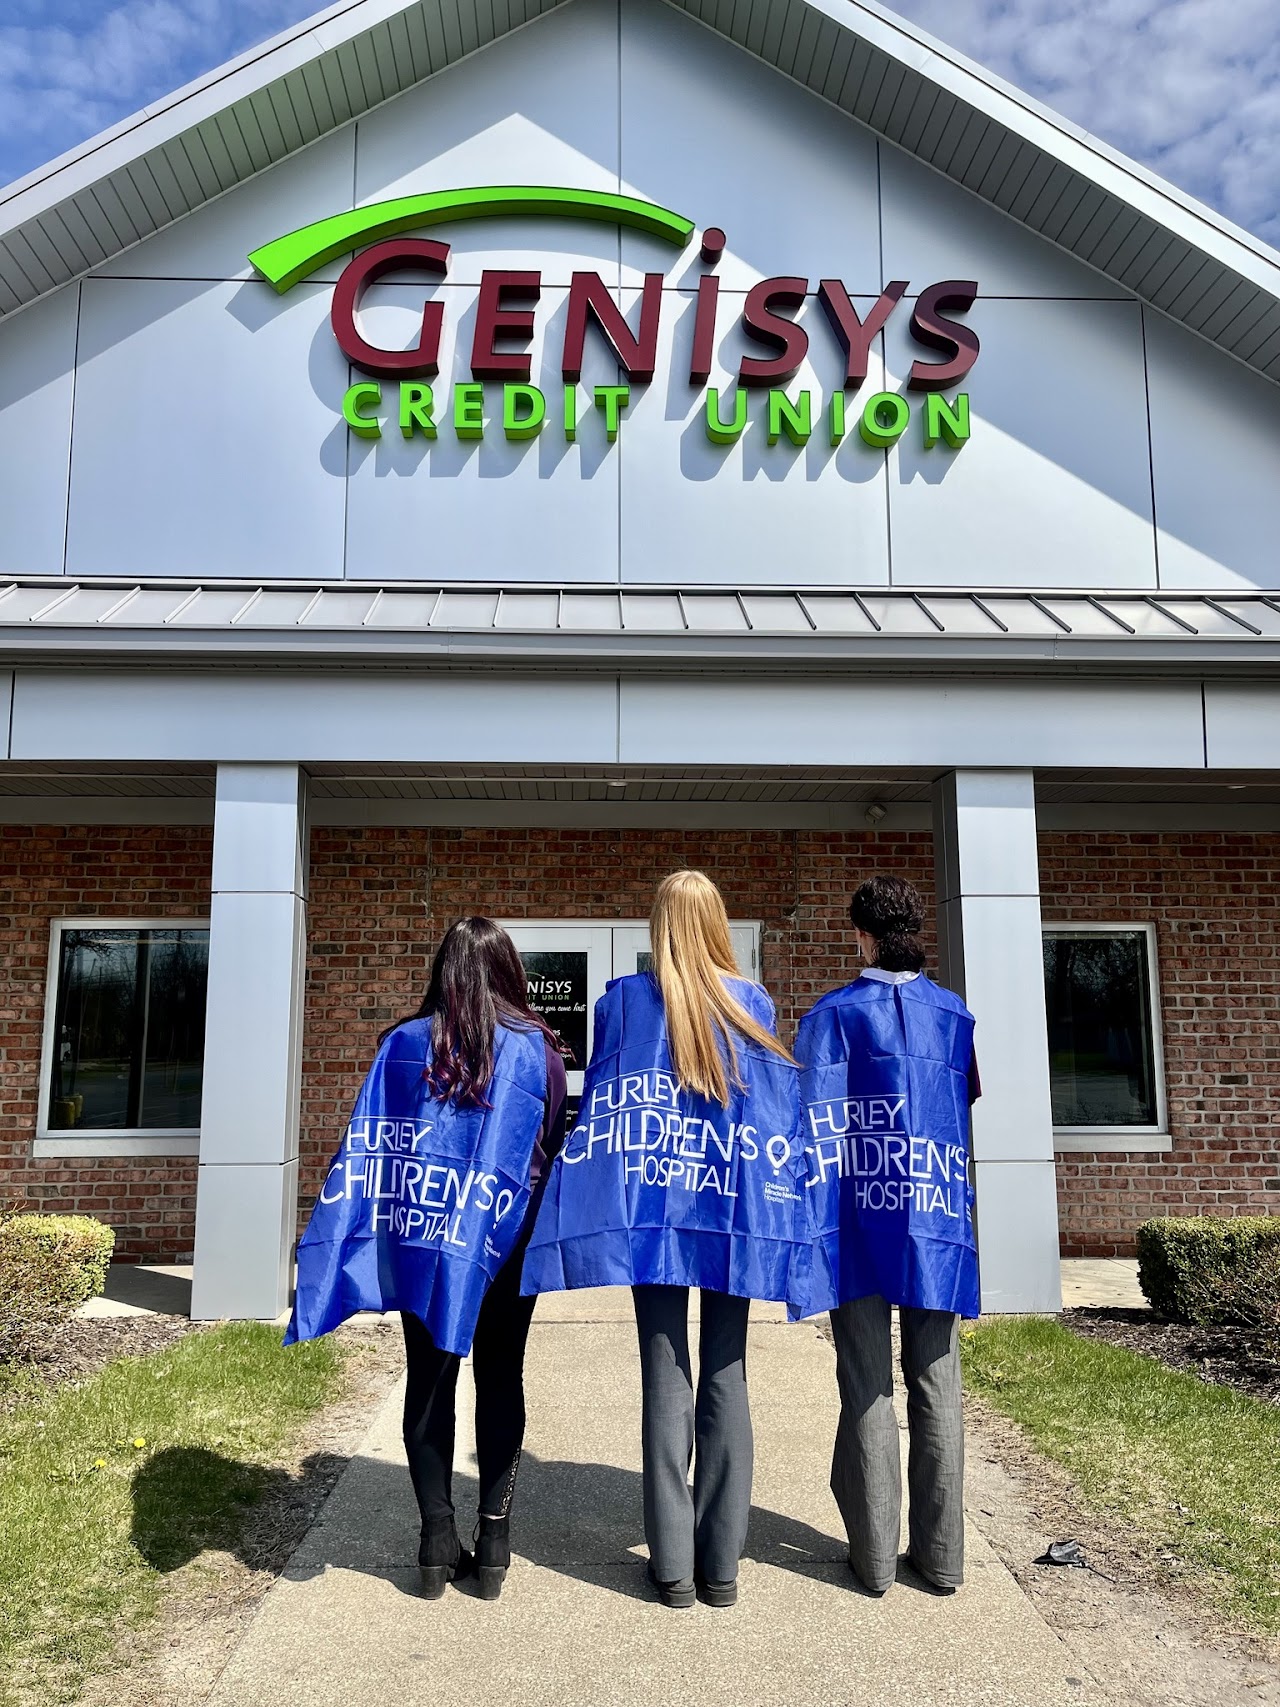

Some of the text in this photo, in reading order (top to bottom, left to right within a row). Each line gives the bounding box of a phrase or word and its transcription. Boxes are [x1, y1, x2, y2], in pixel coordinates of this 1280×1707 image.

[342, 382, 972, 449] CREDIT UNION
[591, 1073, 682, 1116] HURLEY
[346, 1121, 433, 1154] HURLEY
[561, 1109, 759, 1165] CHILDREN'S
[809, 1099, 906, 1137] HURLEY
[320, 1158, 498, 1211] CHILDREN'S
[625, 1154, 739, 1198] HOSPITAL
[855, 1180, 959, 1218] HOSPITAL
